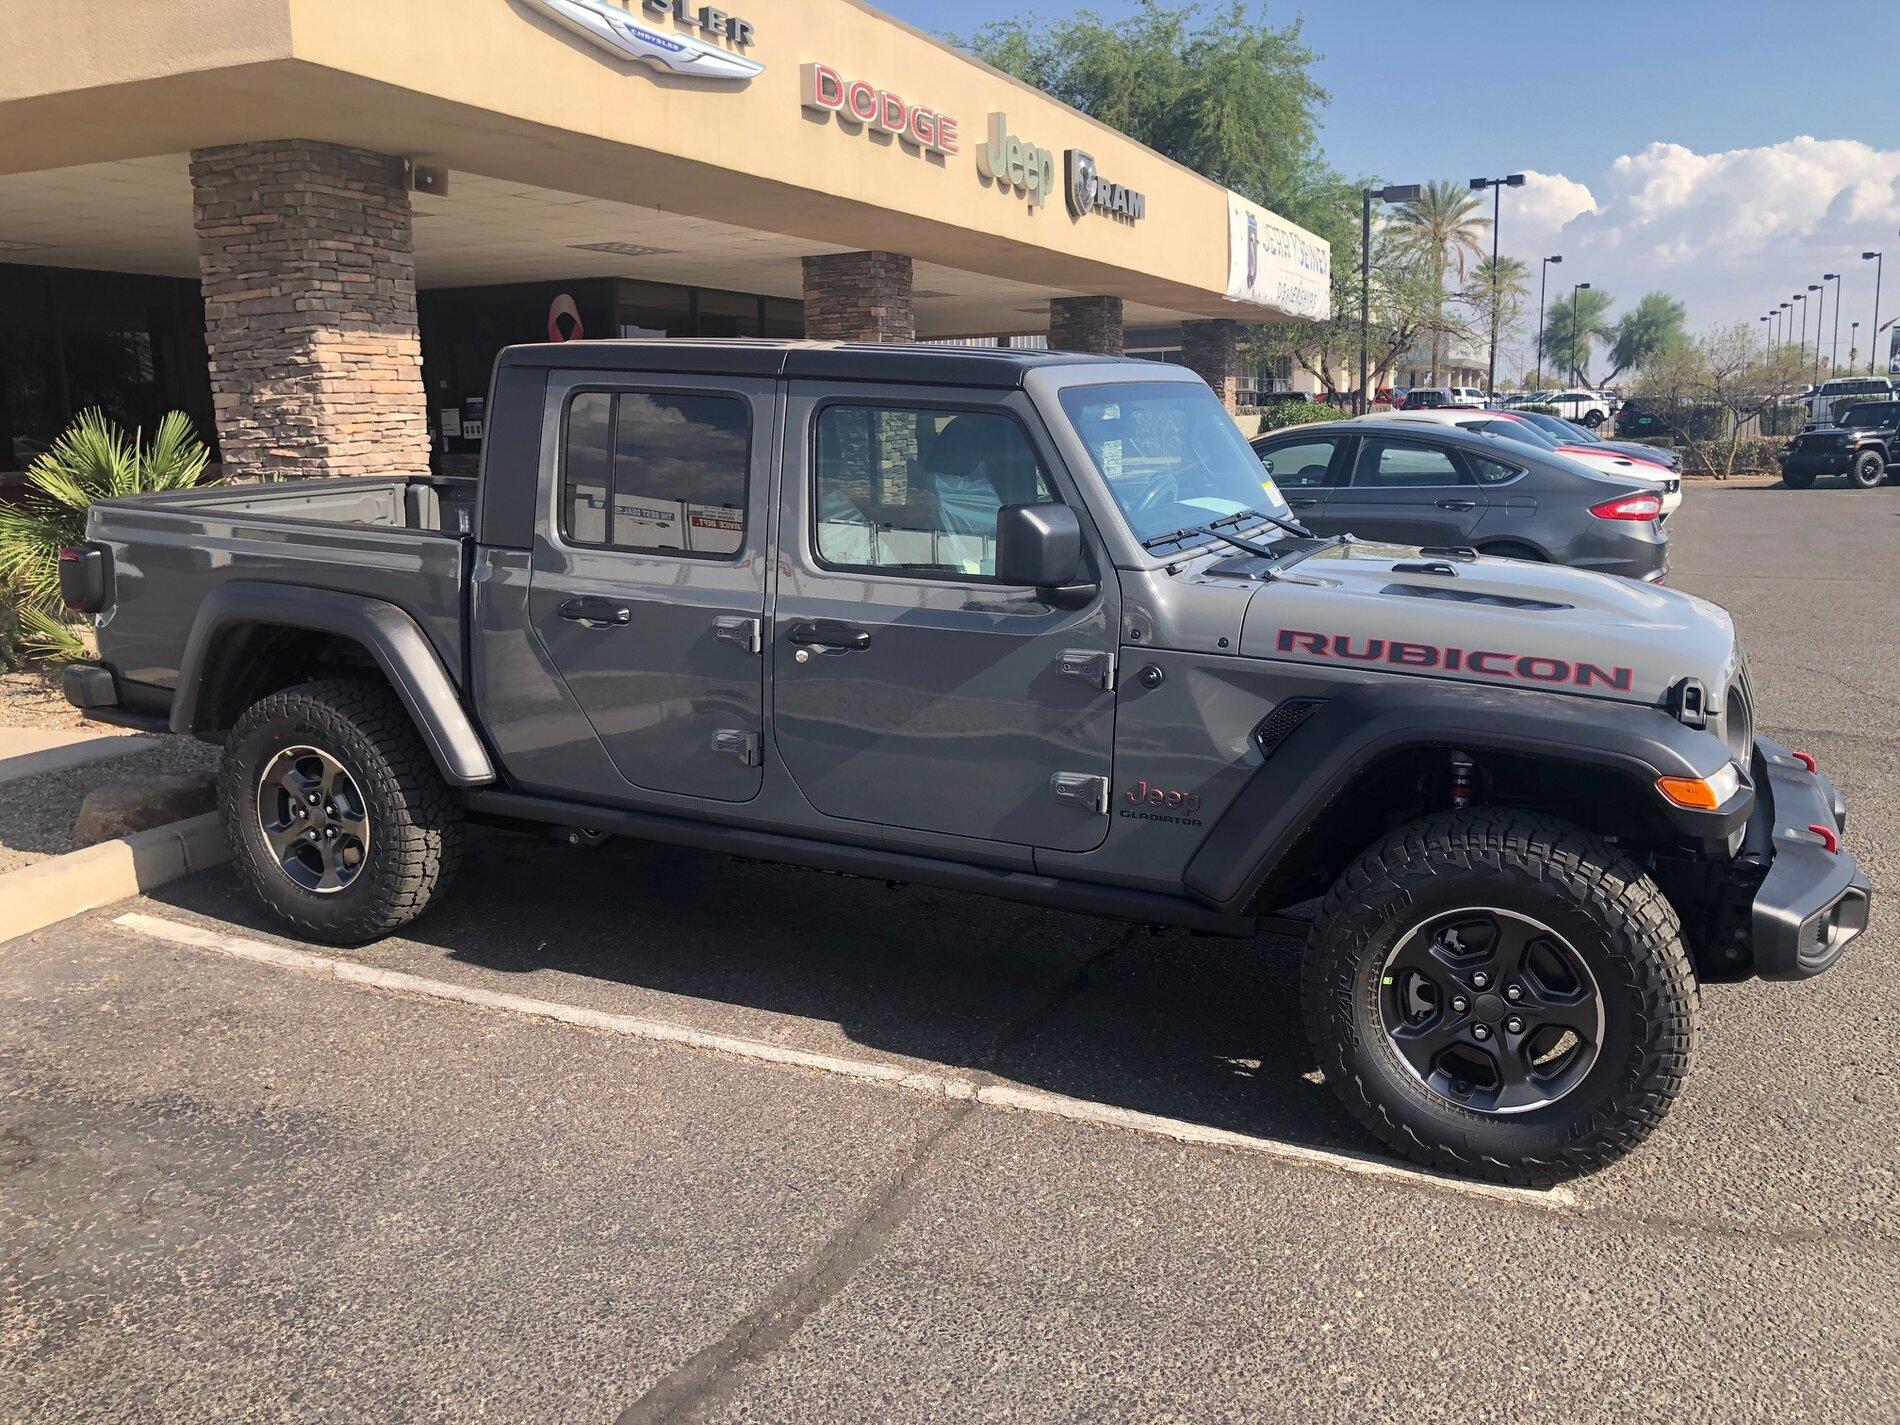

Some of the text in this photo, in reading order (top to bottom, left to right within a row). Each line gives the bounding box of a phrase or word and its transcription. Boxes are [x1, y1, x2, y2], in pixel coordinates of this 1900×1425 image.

[630, 28, 680, 51] CHRYSLER
[801, 62, 960, 157] DODGE
[976, 112, 1056, 209] Jeep
[1094, 176, 1146, 220] RAM
[1275, 627, 1633, 692] RUBICON
[1120, 809, 1202, 827] GLADIATOR
[1124, 779, 1200, 817] Jeep
